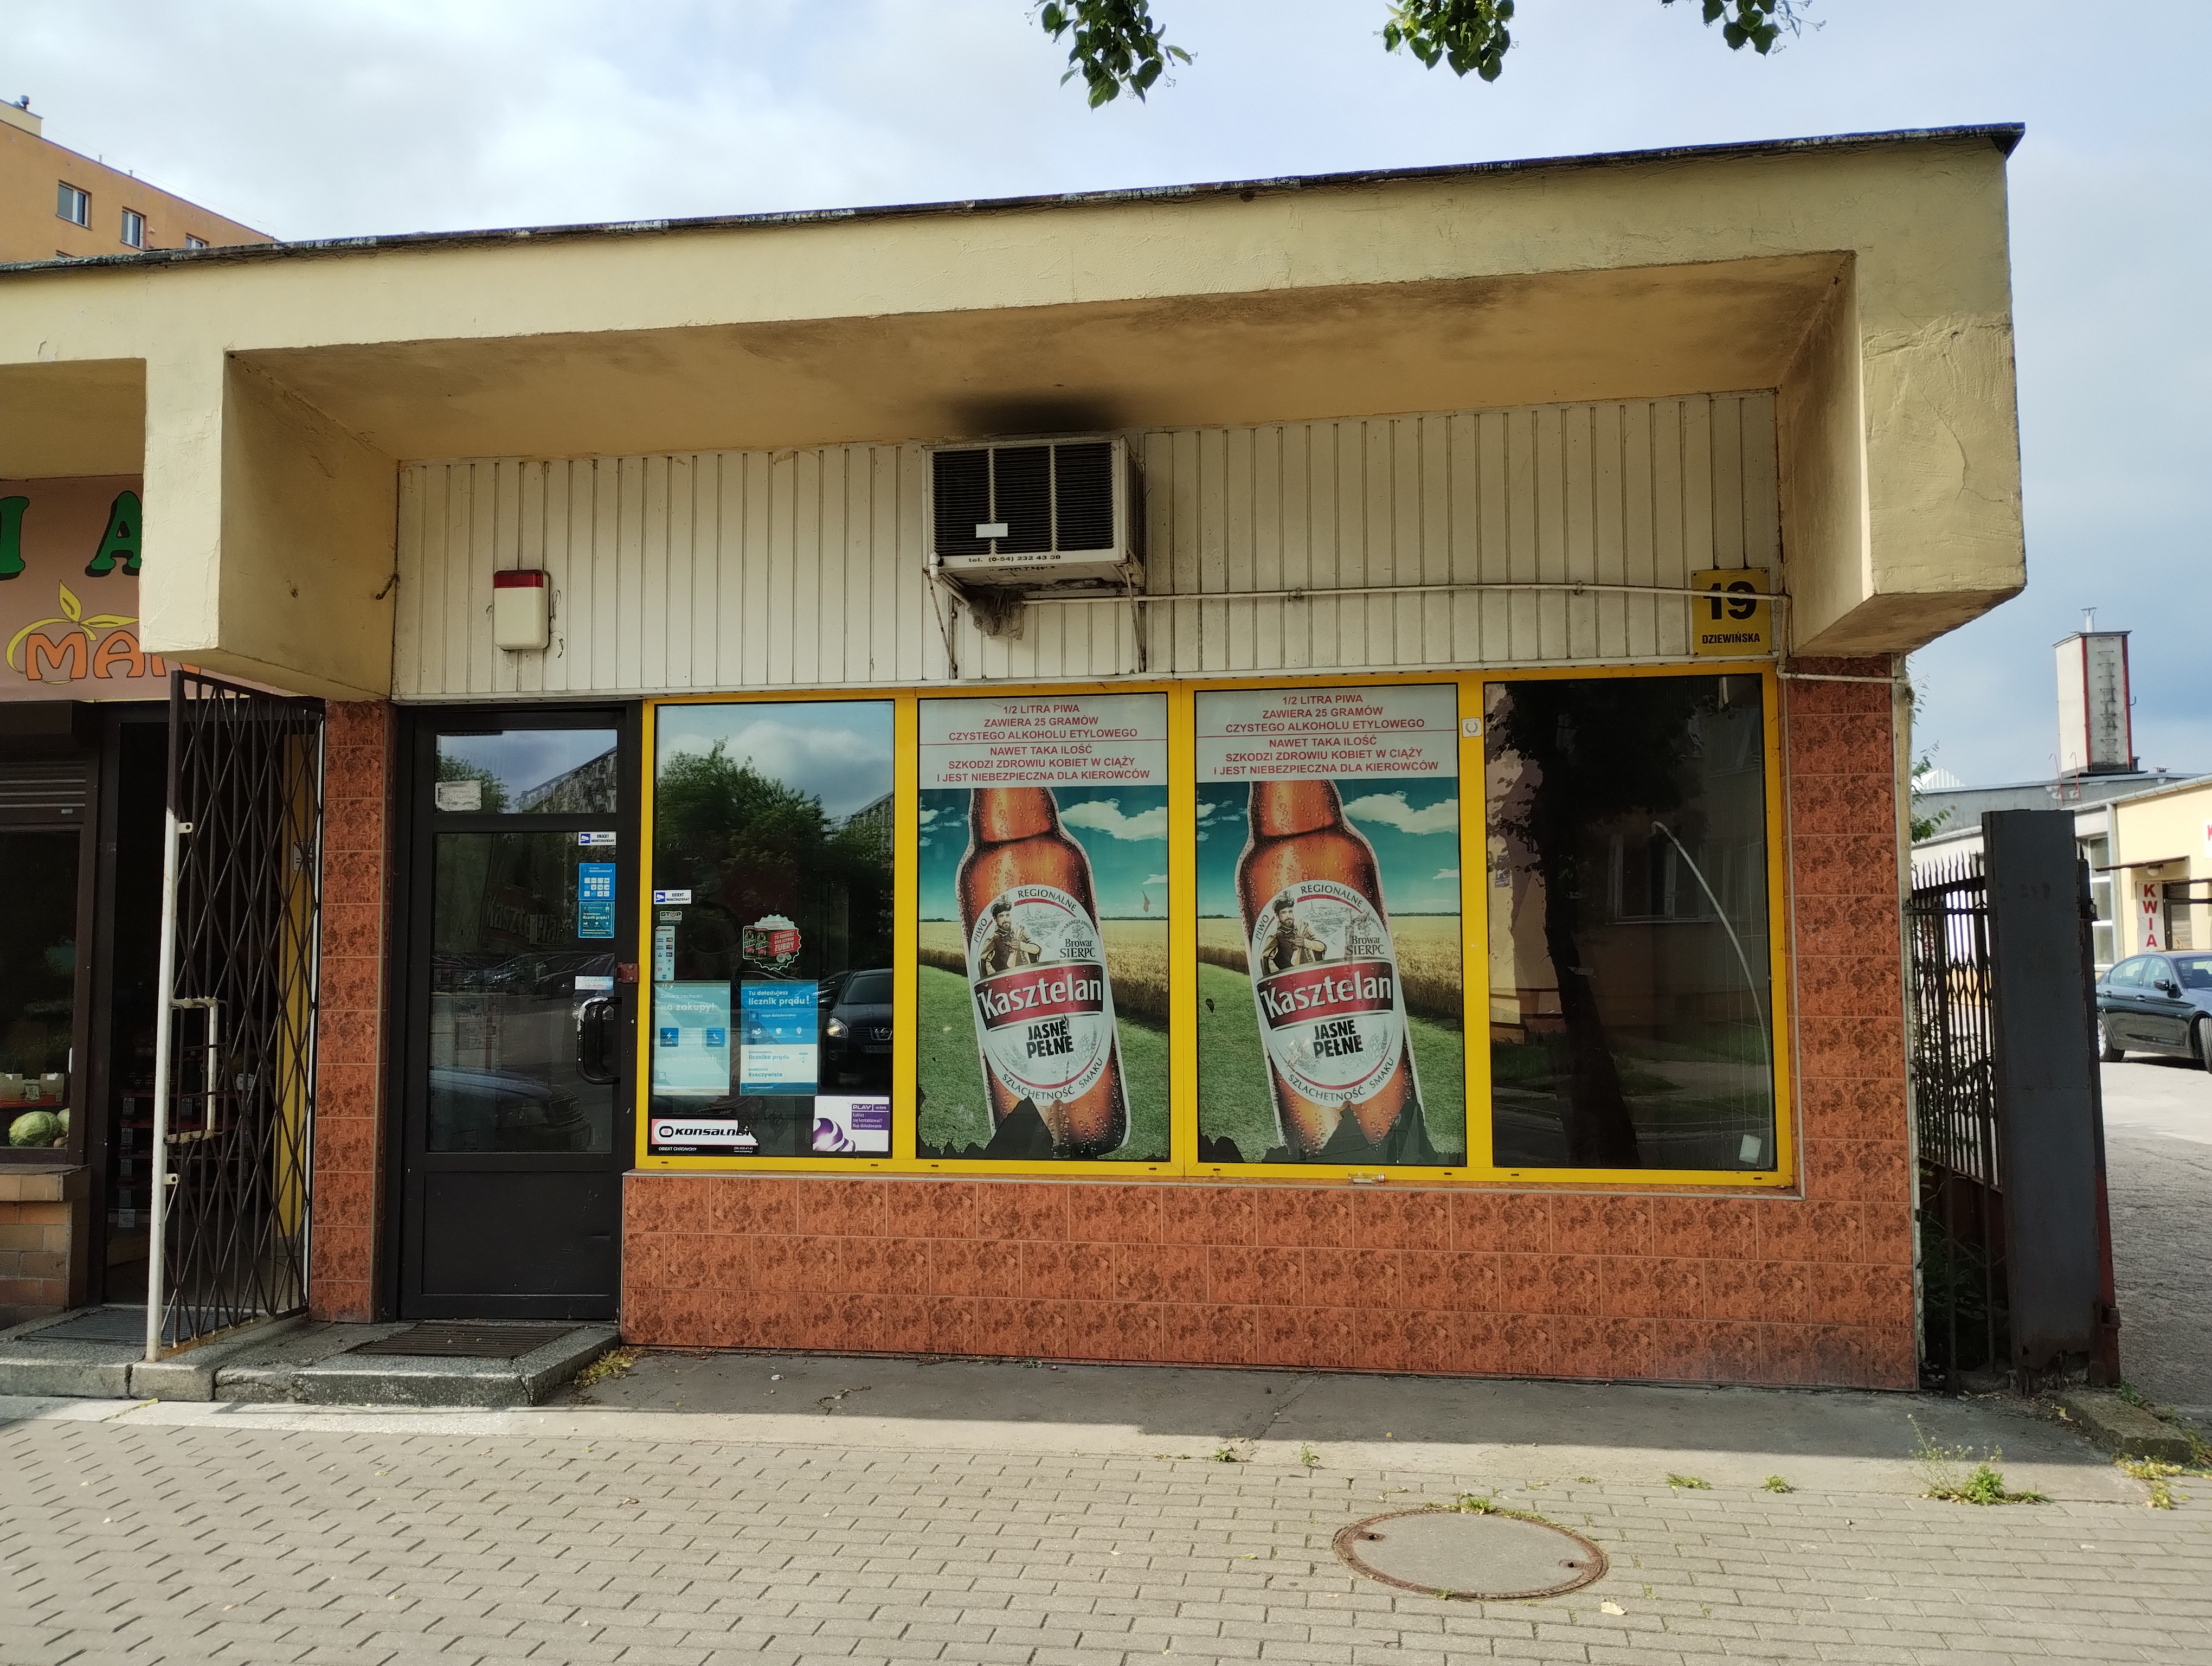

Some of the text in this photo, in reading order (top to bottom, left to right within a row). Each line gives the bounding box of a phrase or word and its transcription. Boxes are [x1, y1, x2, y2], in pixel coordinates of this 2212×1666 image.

[1703, 581, 1757, 620] 19
[1702, 632, 1760, 644] DZIEWIŃSKA
[1282, 694, 1363, 706] 1/2 LITRA PIWA
[1003, 704, 1079, 715] 1/2 LITRA PIWA
[1262, 706, 1383, 719] ZAWIERA 25 GRAMÓW
[984, 715, 1098, 728] ZAWIERA 25 GRAMÓW
[1225, 719, 1425, 733] CZYSTEGO ALKOHOLU ETYLOWEGO
[949, 729, 1137, 741] CZYSTEGO ALKOHOLU ETYLOWEGO
[1269, 735, 1377, 748] NAWET TAKA ILOŚĆ
[990, 744, 1092, 755] NAWET TAKA ILOŚĆ
[1225, 747, 1423, 762] SZKODZI ZDROWIU KOBIET W CIĄŻY
[948, 755, 1135, 770] SZKODZI ZDROWIU KOBIET W CIĄŻY
[1214, 760, 1438, 776] I JEST NIEBEZPIECZNA DLA KIEROWCÓW
[937, 768, 1150, 781] I JEST NIEBEZPIECZNA DLA KIEROWCÓW
[974, 889, 1077, 943] PIWO REGIONALNE
[1256, 885, 1363, 940] PIWO REGIONALNE
[1065, 938, 1093, 947] Browar
[1352, 935, 1381, 945] Browar
[1060, 948, 1096, 958] SIERPC
[1346, 945, 1384, 955] SIERPC
[978, 973, 1102, 1020] Kasztelan
[1260, 971, 1391, 1018] Kasztelan
[676, 1002, 715, 1013] zakupy!
[1028, 1020, 1067, 1040] JASNE
[1315, 1020, 1356, 1040] JASNE
[1026, 1036, 1074, 1059] PEŁNE
[1313, 1035, 1363, 1058] PEŁNE
[1002, 1058, 1103, 1100] SZLACHETNOŚĆ SMAKU
[1289, 1058, 1394, 1101] SZLACHETNOŚĆ SMAKU
